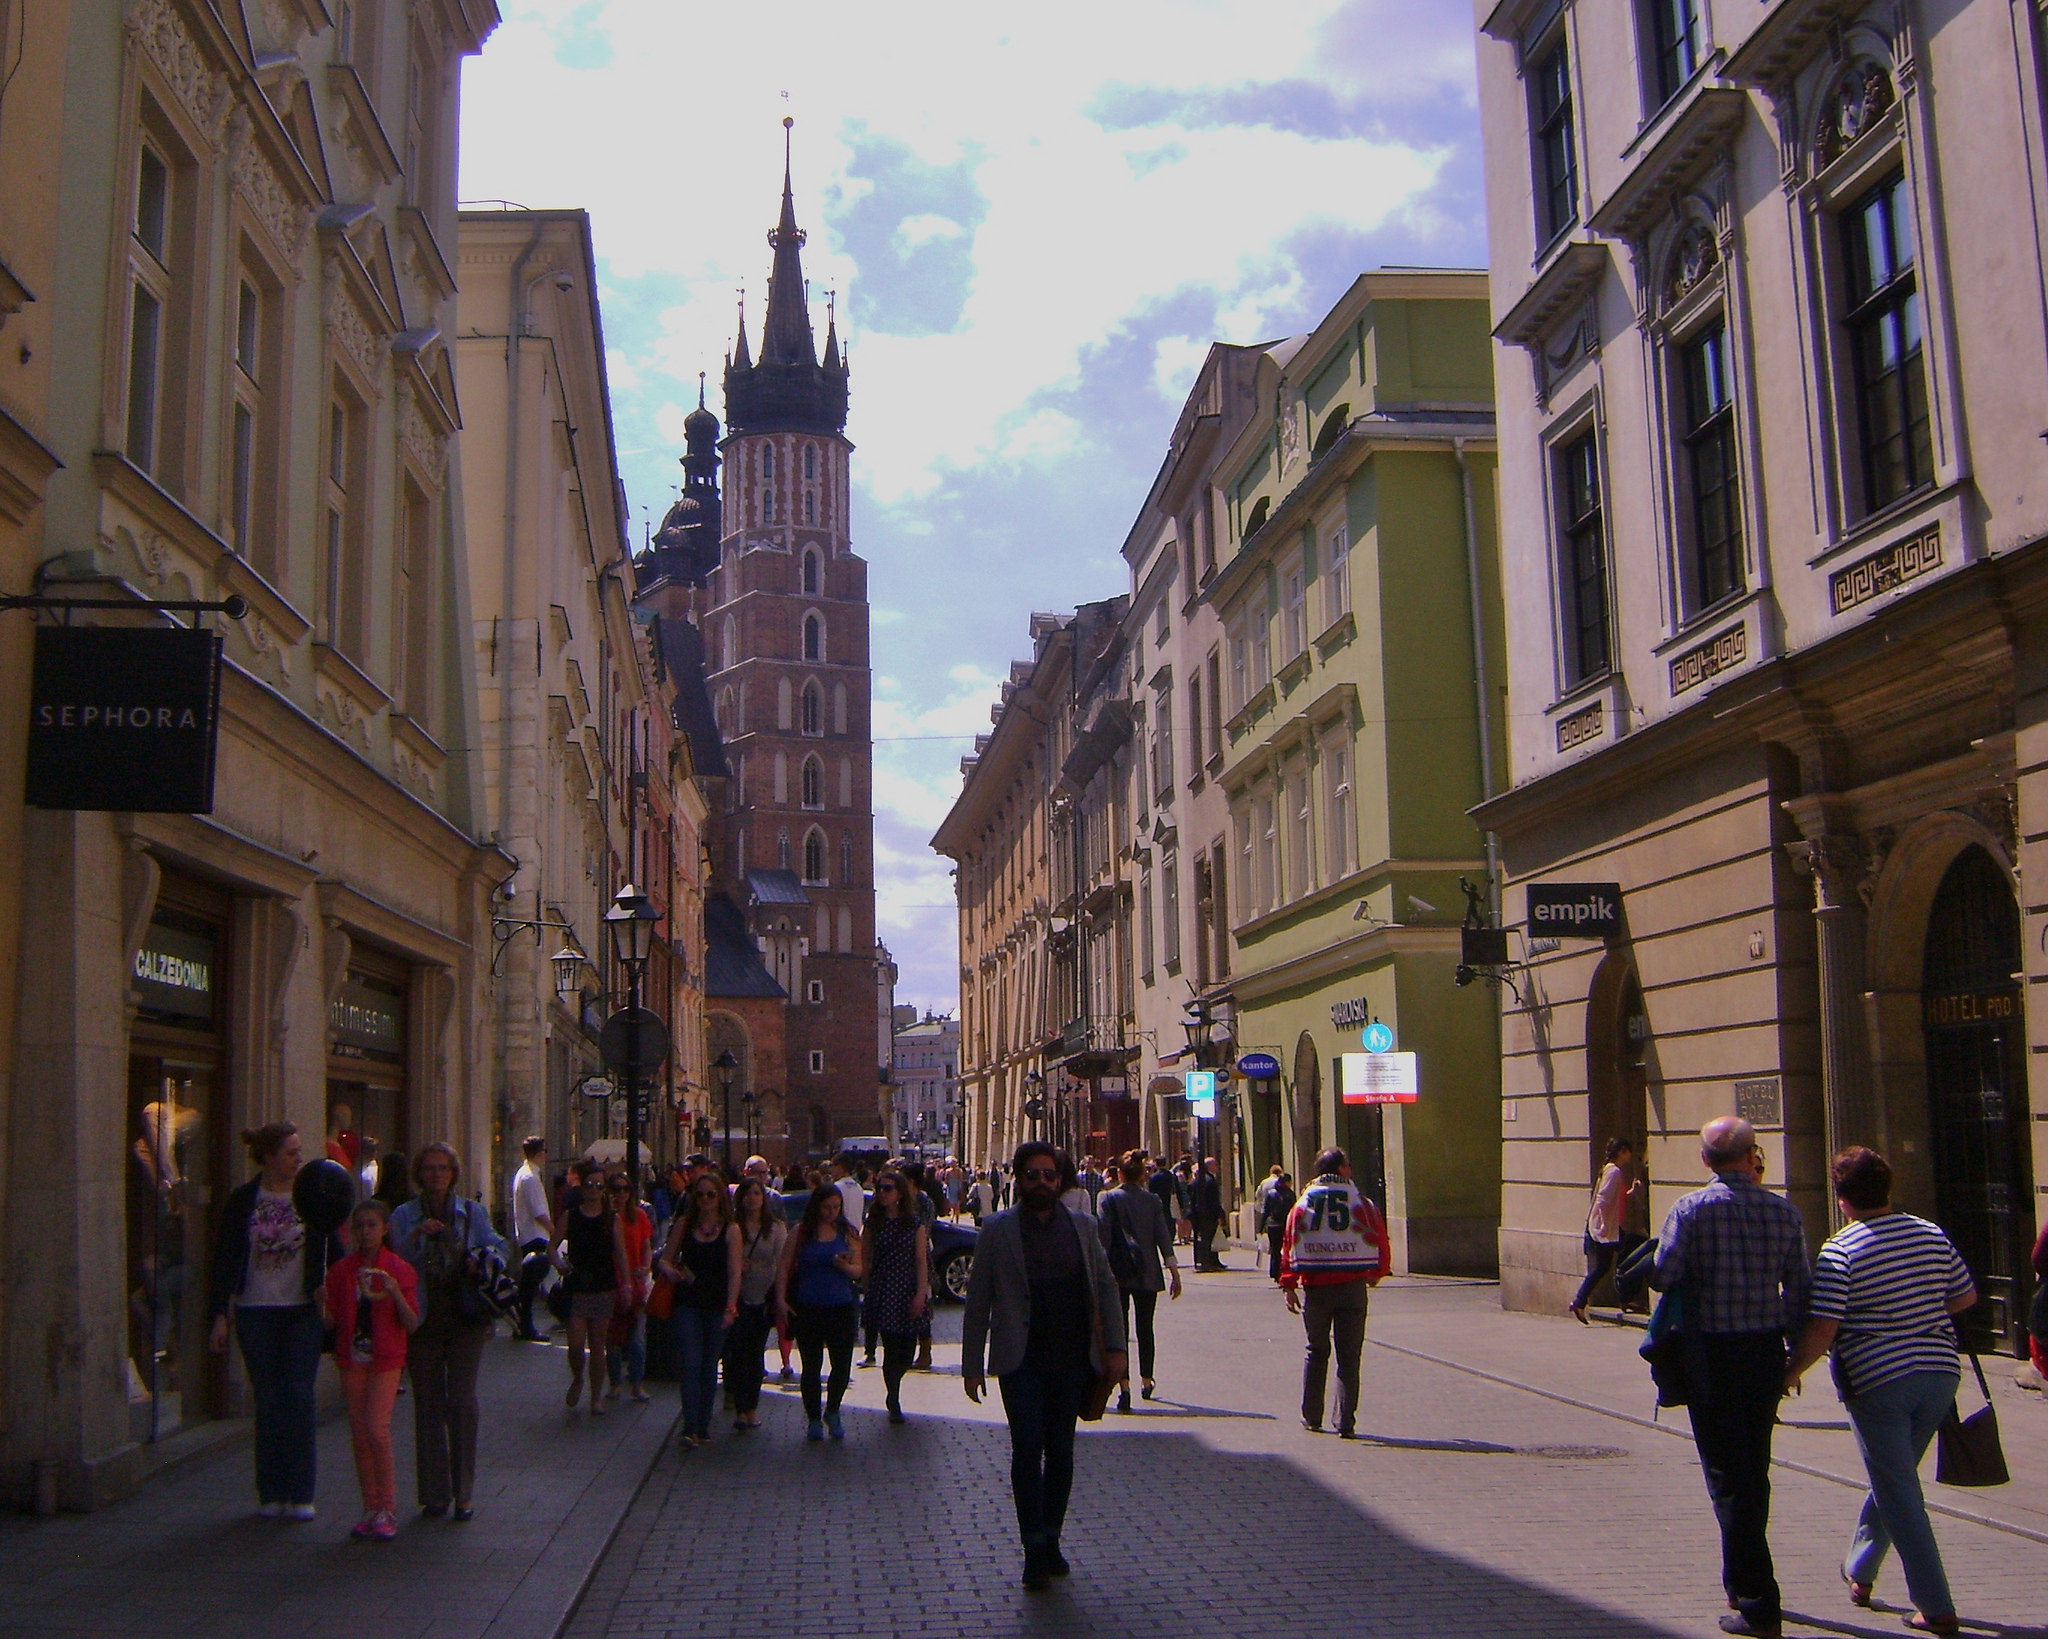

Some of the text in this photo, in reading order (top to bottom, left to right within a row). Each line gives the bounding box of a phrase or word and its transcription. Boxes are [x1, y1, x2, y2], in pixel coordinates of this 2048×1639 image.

[38, 705, 197, 729] SEPHORA
[1533, 895, 1614, 925] empik
[135, 948, 208, 992] CALZEDONIA
[331, 996, 396, 1039] ntimissimi
[1927, 994, 1982, 1024] HOTEL
[1241, 1061, 1275, 1070] kantor
[1191, 1074, 1209, 1096] P
[1739, 1084, 1775, 1100] HOTEL
[1389, 1094, 1396, 1102] A
[1307, 1190, 1350, 1231] 75
[1303, 1242, 1357, 1253] HUNGARY
